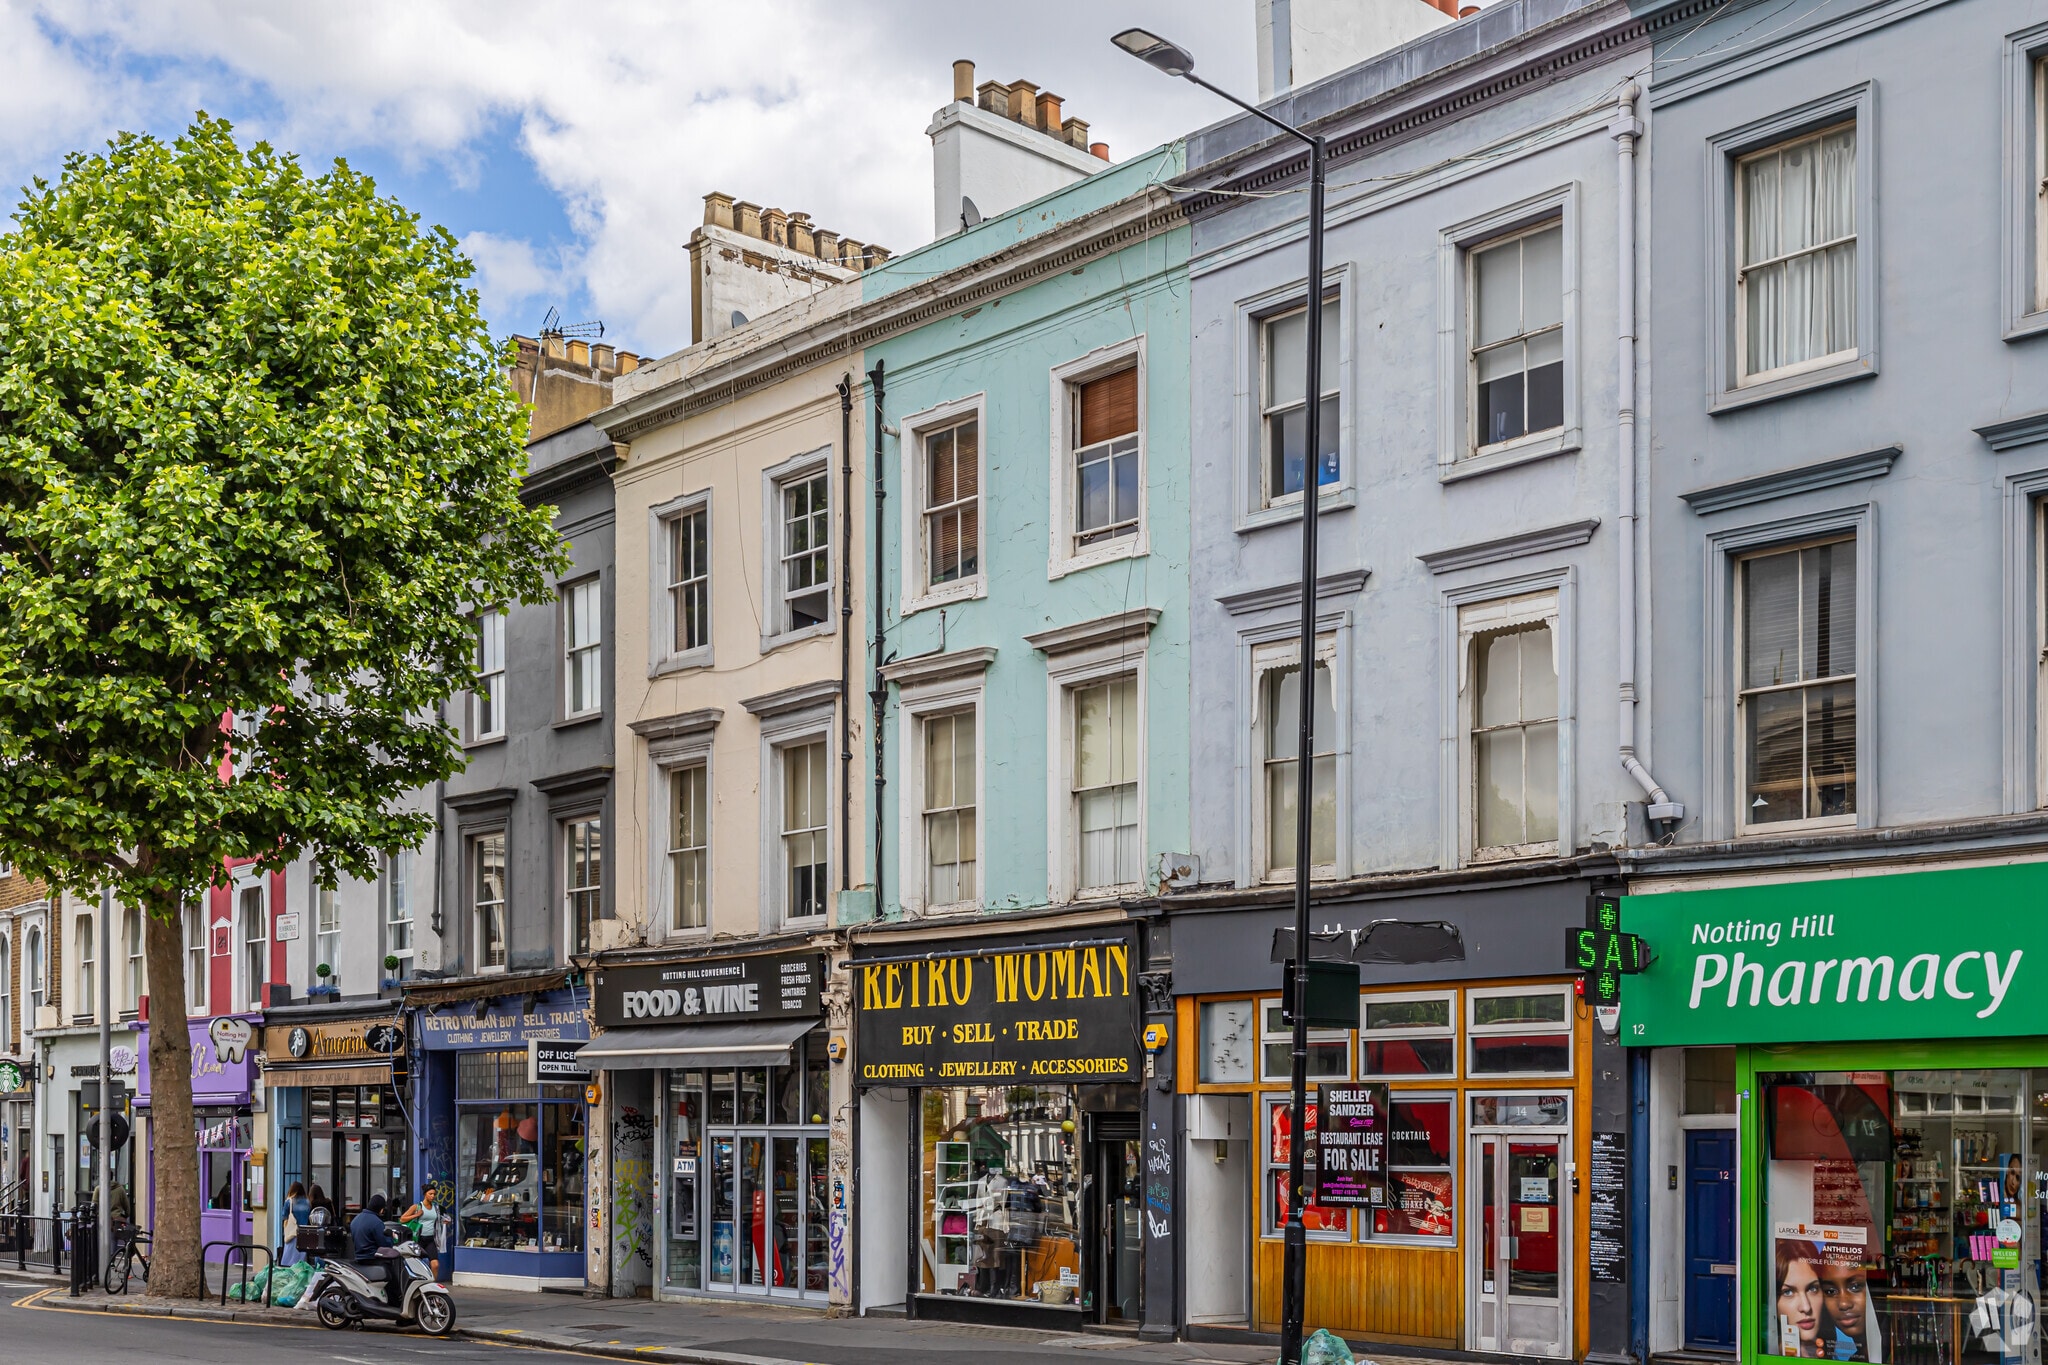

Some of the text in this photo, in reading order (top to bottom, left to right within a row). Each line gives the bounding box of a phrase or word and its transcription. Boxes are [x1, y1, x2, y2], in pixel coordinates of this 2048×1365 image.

[1691, 914, 1835, 947] Notting Hill
[662, 966, 741, 981] NOTTING HILL CONVENIENCE
[780, 962, 807, 974] GROCERIES
[780, 974, 811, 985] FRESH FRUITS
[862, 946, 1129, 1010] RETRO WOMAN
[1688, 950, 2023, 1019] Pharmacy
[781, 987, 807, 997] SANITARIES
[622, 983, 759, 1019] FOOD & WINE
[781, 999, 802, 1010] TOBACCO
[425, 1015, 460, 1031] RETRO
[499, 1016, 516, 1028] BUY
[523, 1013, 546, 1027] SELL
[549, 1010, 582, 1025] TRADE
[217, 1030, 236, 1039] Notting
[902, 1018, 1079, 1046] BUY SELL TRADE
[1632, 1023, 1645, 1035] 12
[312, 1027, 369, 1056] Amorin
[447, 1028, 560, 1044] CLOTHING JEWELLERY ACCESSORIES
[538, 1050, 554, 1059] OFF
[863, 1057, 1129, 1078] CLOTHING JEWELLERY ACCESSORIES
[1329, 1090, 1372, 1103] SHELLEY
[1329, 1104, 1374, 1116] SANDZER
[1516, 1106, 1527, 1116] 14
[1320, 1132, 1361, 1145] RESTAURANT
[1362, 1132, 1383, 1145] LEASE
[1391, 1130, 1431, 1141] COCKTAILS
[677, 1160, 695, 1171] ATM
[1323, 1148, 1348, 1171] FOR
[1350, 1148, 1380, 1172] SALE
[1719, 1170, 1729, 1180] 12
[1400, 1200, 1424, 1210] SHAKE
[1822, 1245, 1863, 1254] ANTHELIOS
